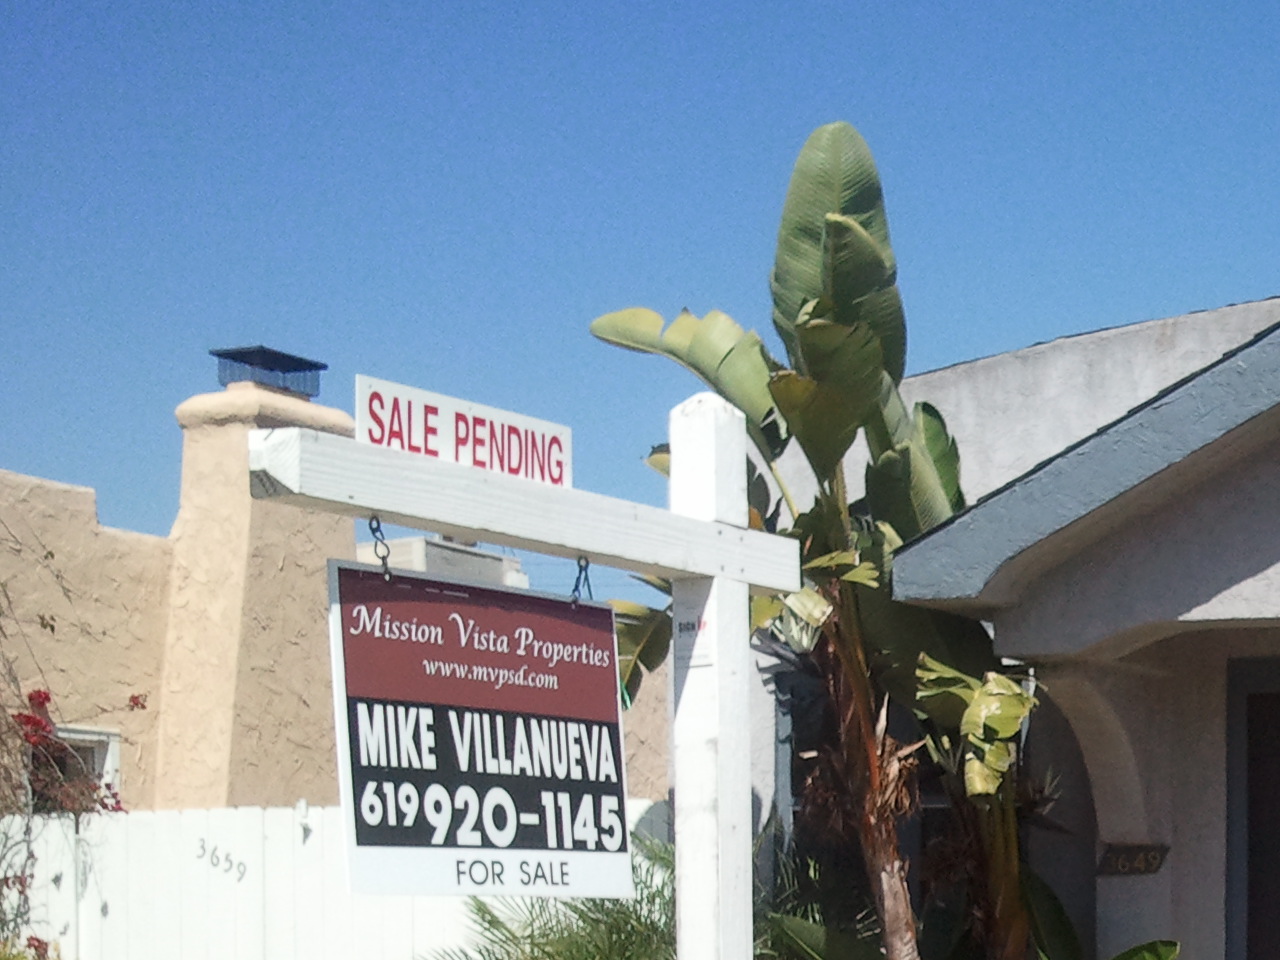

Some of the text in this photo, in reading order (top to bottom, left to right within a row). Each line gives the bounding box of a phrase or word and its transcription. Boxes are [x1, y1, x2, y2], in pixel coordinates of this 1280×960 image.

[368, 391, 564, 485] SALE PENDING
[349, 604, 610, 668] Mission Vista Properties
[422, 659, 559, 691] www.mvpsd.com
[356, 701, 617, 783] MIKE VILLANUEVA
[360, 780, 623, 852] 619 920-1145
[197, 838, 246, 882] 3659
[456, 859, 570, 886] FOR SALE
